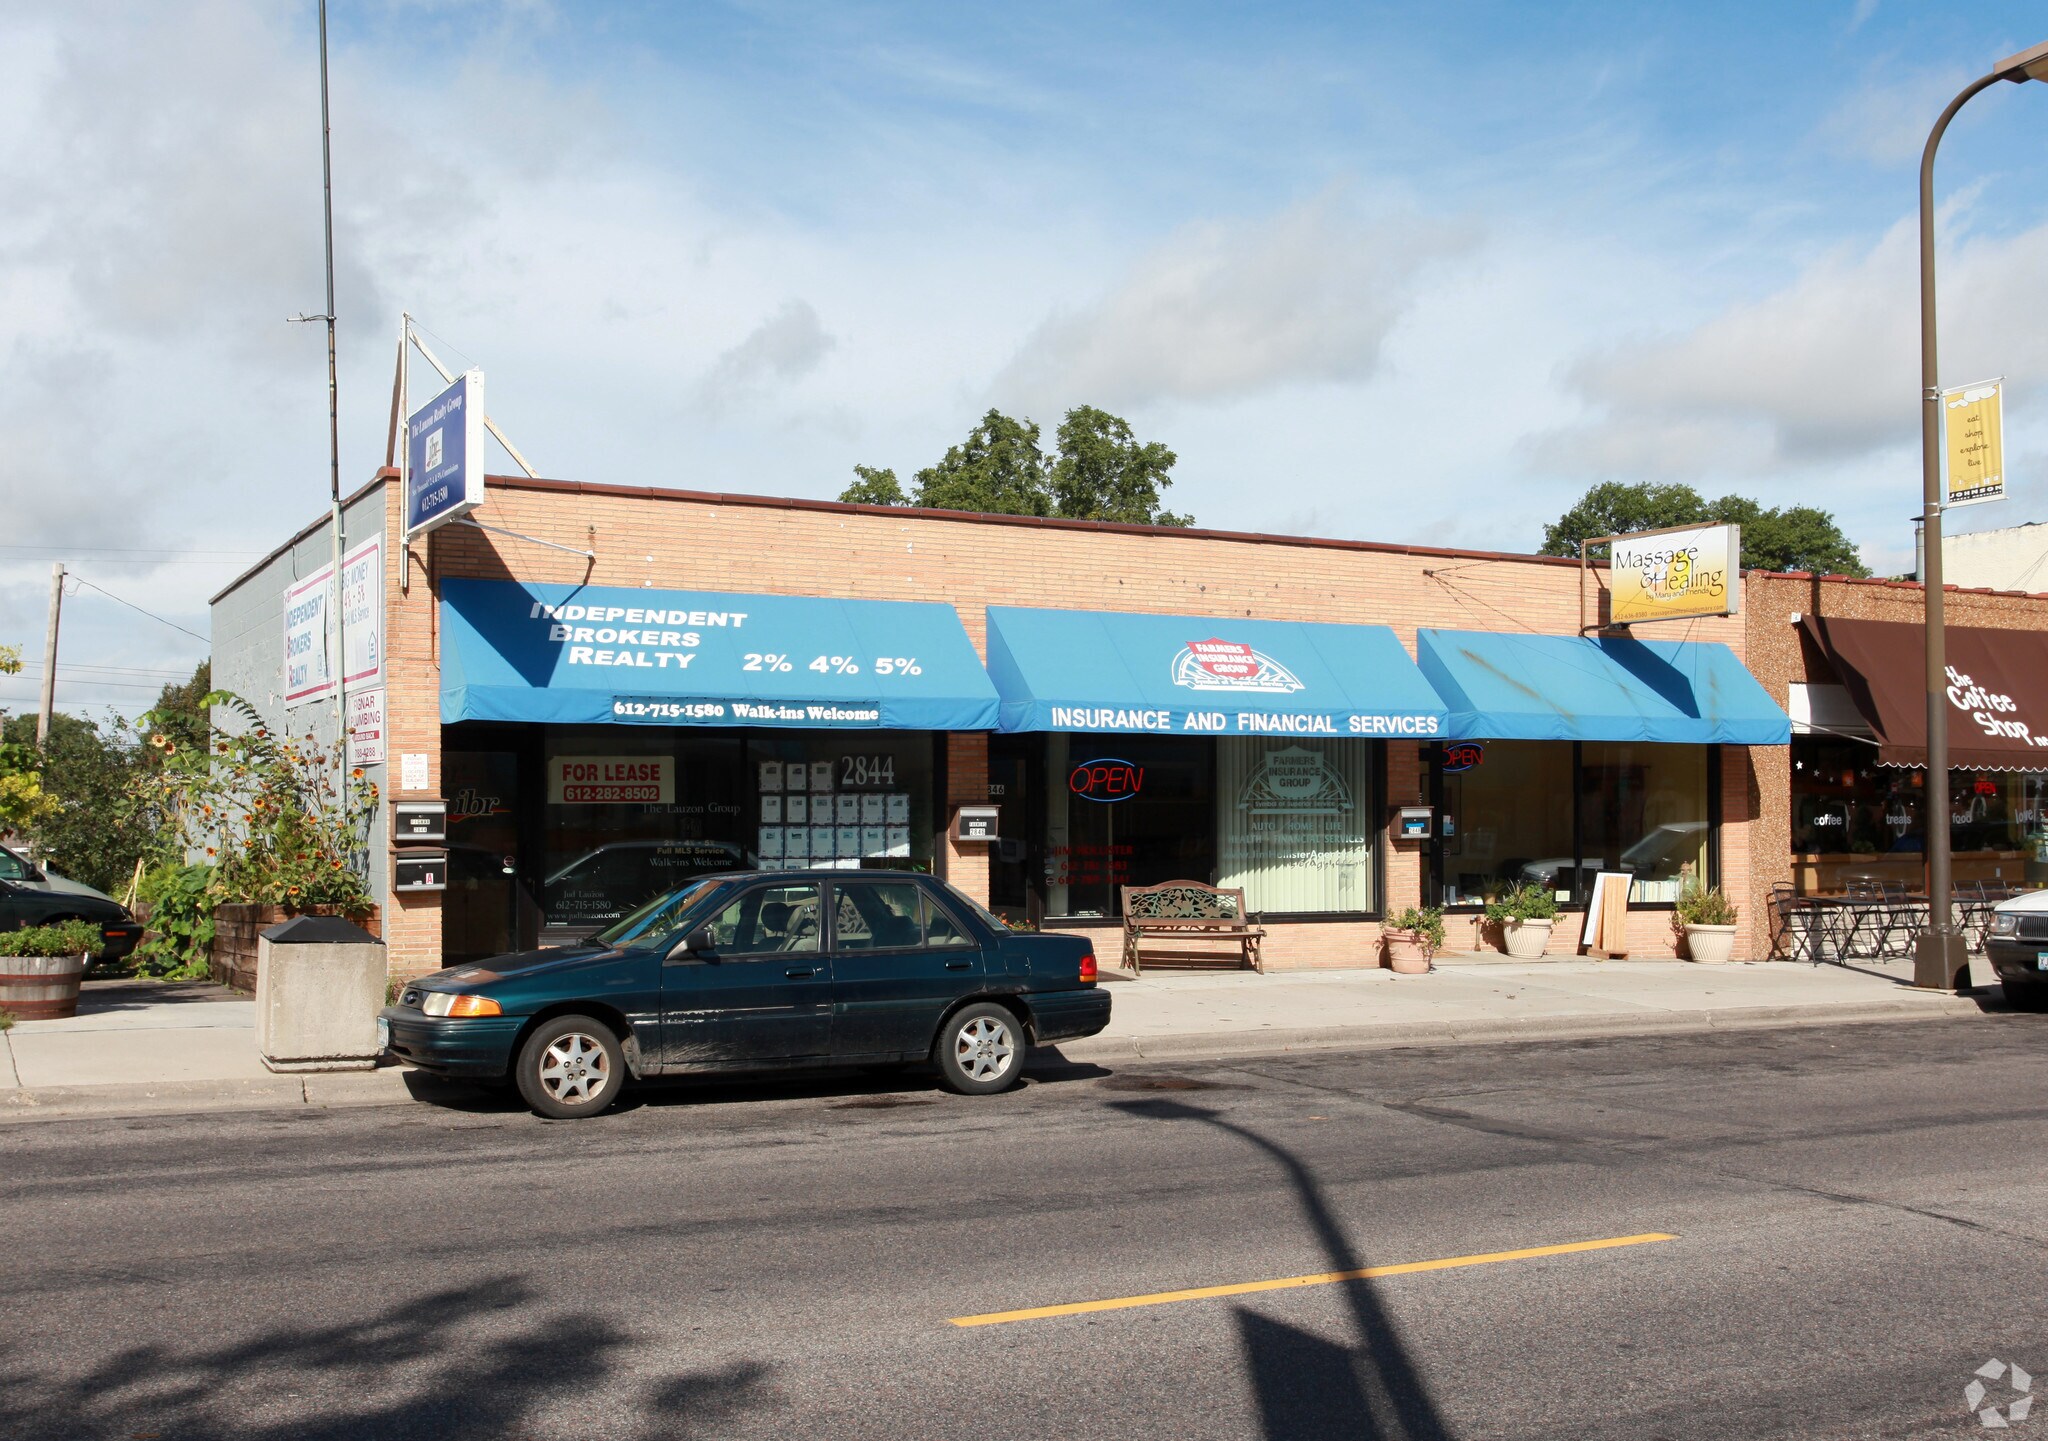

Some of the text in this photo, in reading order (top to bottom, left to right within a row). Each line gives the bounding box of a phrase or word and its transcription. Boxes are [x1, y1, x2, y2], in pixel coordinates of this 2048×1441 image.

[447, 395, 462, 413] Group
[1967, 415, 1980, 423] eat
[1965, 429, 1984, 439] shop
[1960, 443, 1989, 455] explore
[421, 485, 449, 512] 612-715-1580
[1949, 485, 2002, 499] JOHNSON
[1615, 546, 1699, 572] Massage
[351, 560, 369, 586] MONEY
[1653, 559, 1724, 597] Healing
[1645, 587, 1709, 602] by Mary and Friends
[286, 593, 323, 631] NDEPENDENT
[530, 602, 748, 628] INDEPENDENT
[548, 624, 701, 647] BROKERS
[287, 629, 312, 660] BROKERS
[1195, 643, 1245, 654] FARMERS
[568, 646, 696, 669] REALTY
[743, 653, 922, 676] 2% 4% 5%
[1195, 653, 1256, 665] INSURANCE
[289, 664, 308, 689] REALTY
[1212, 664, 1249, 674] GROUP
[1945, 665, 1974, 687] the
[1946, 685, 2017, 712] Coffee
[350, 710, 381, 728] PLUMBING
[613, 701, 879, 722] 612-715-1580 Walk-ins Welcome
[1051, 707, 1438, 734] INSURANCE AND FINANCIAL SERVICES
[1973, 711, 2034, 746] Shop
[1273, 756, 1316, 765] FARMERS
[1442, 749, 1484, 766] OPEN
[562, 764, 661, 781] FOR LEASE
[841, 756, 895, 785] 2844
[1269, 767, 1321, 776] INSURANCE
[1069, 767, 1144, 793] OPEN
[1279, 778, 1311, 787] GROUP
[1974, 781, 1997, 794] OPEN
[566, 787, 657, 800] 612-282-8502
[987, 785, 1004, 794] 846
[453, 788, 500, 816] ibr
[642, 802, 741, 817] The Lauzon Group
[1813, 814, 1842, 826] coffee
[1886, 814, 1912, 825] treats
[1952, 813, 1971, 824] food
[2014, 808, 2034, 825] love
[1251, 822, 1343, 831] AUTO HOME LIFE
[1228, 834, 1365, 844] HEALTH FINANCIAL SERVICES
[1054, 846, 1073, 857] JIM
[649, 857, 733, 867] Walk-ins Welcome
[426, 873, 433, 883] A
[563, 890, 604, 899] Jud Lauzon
[555, 901, 612, 910] 612-715-1580
[547, 911, 620, 920] www.judlauzon.com
